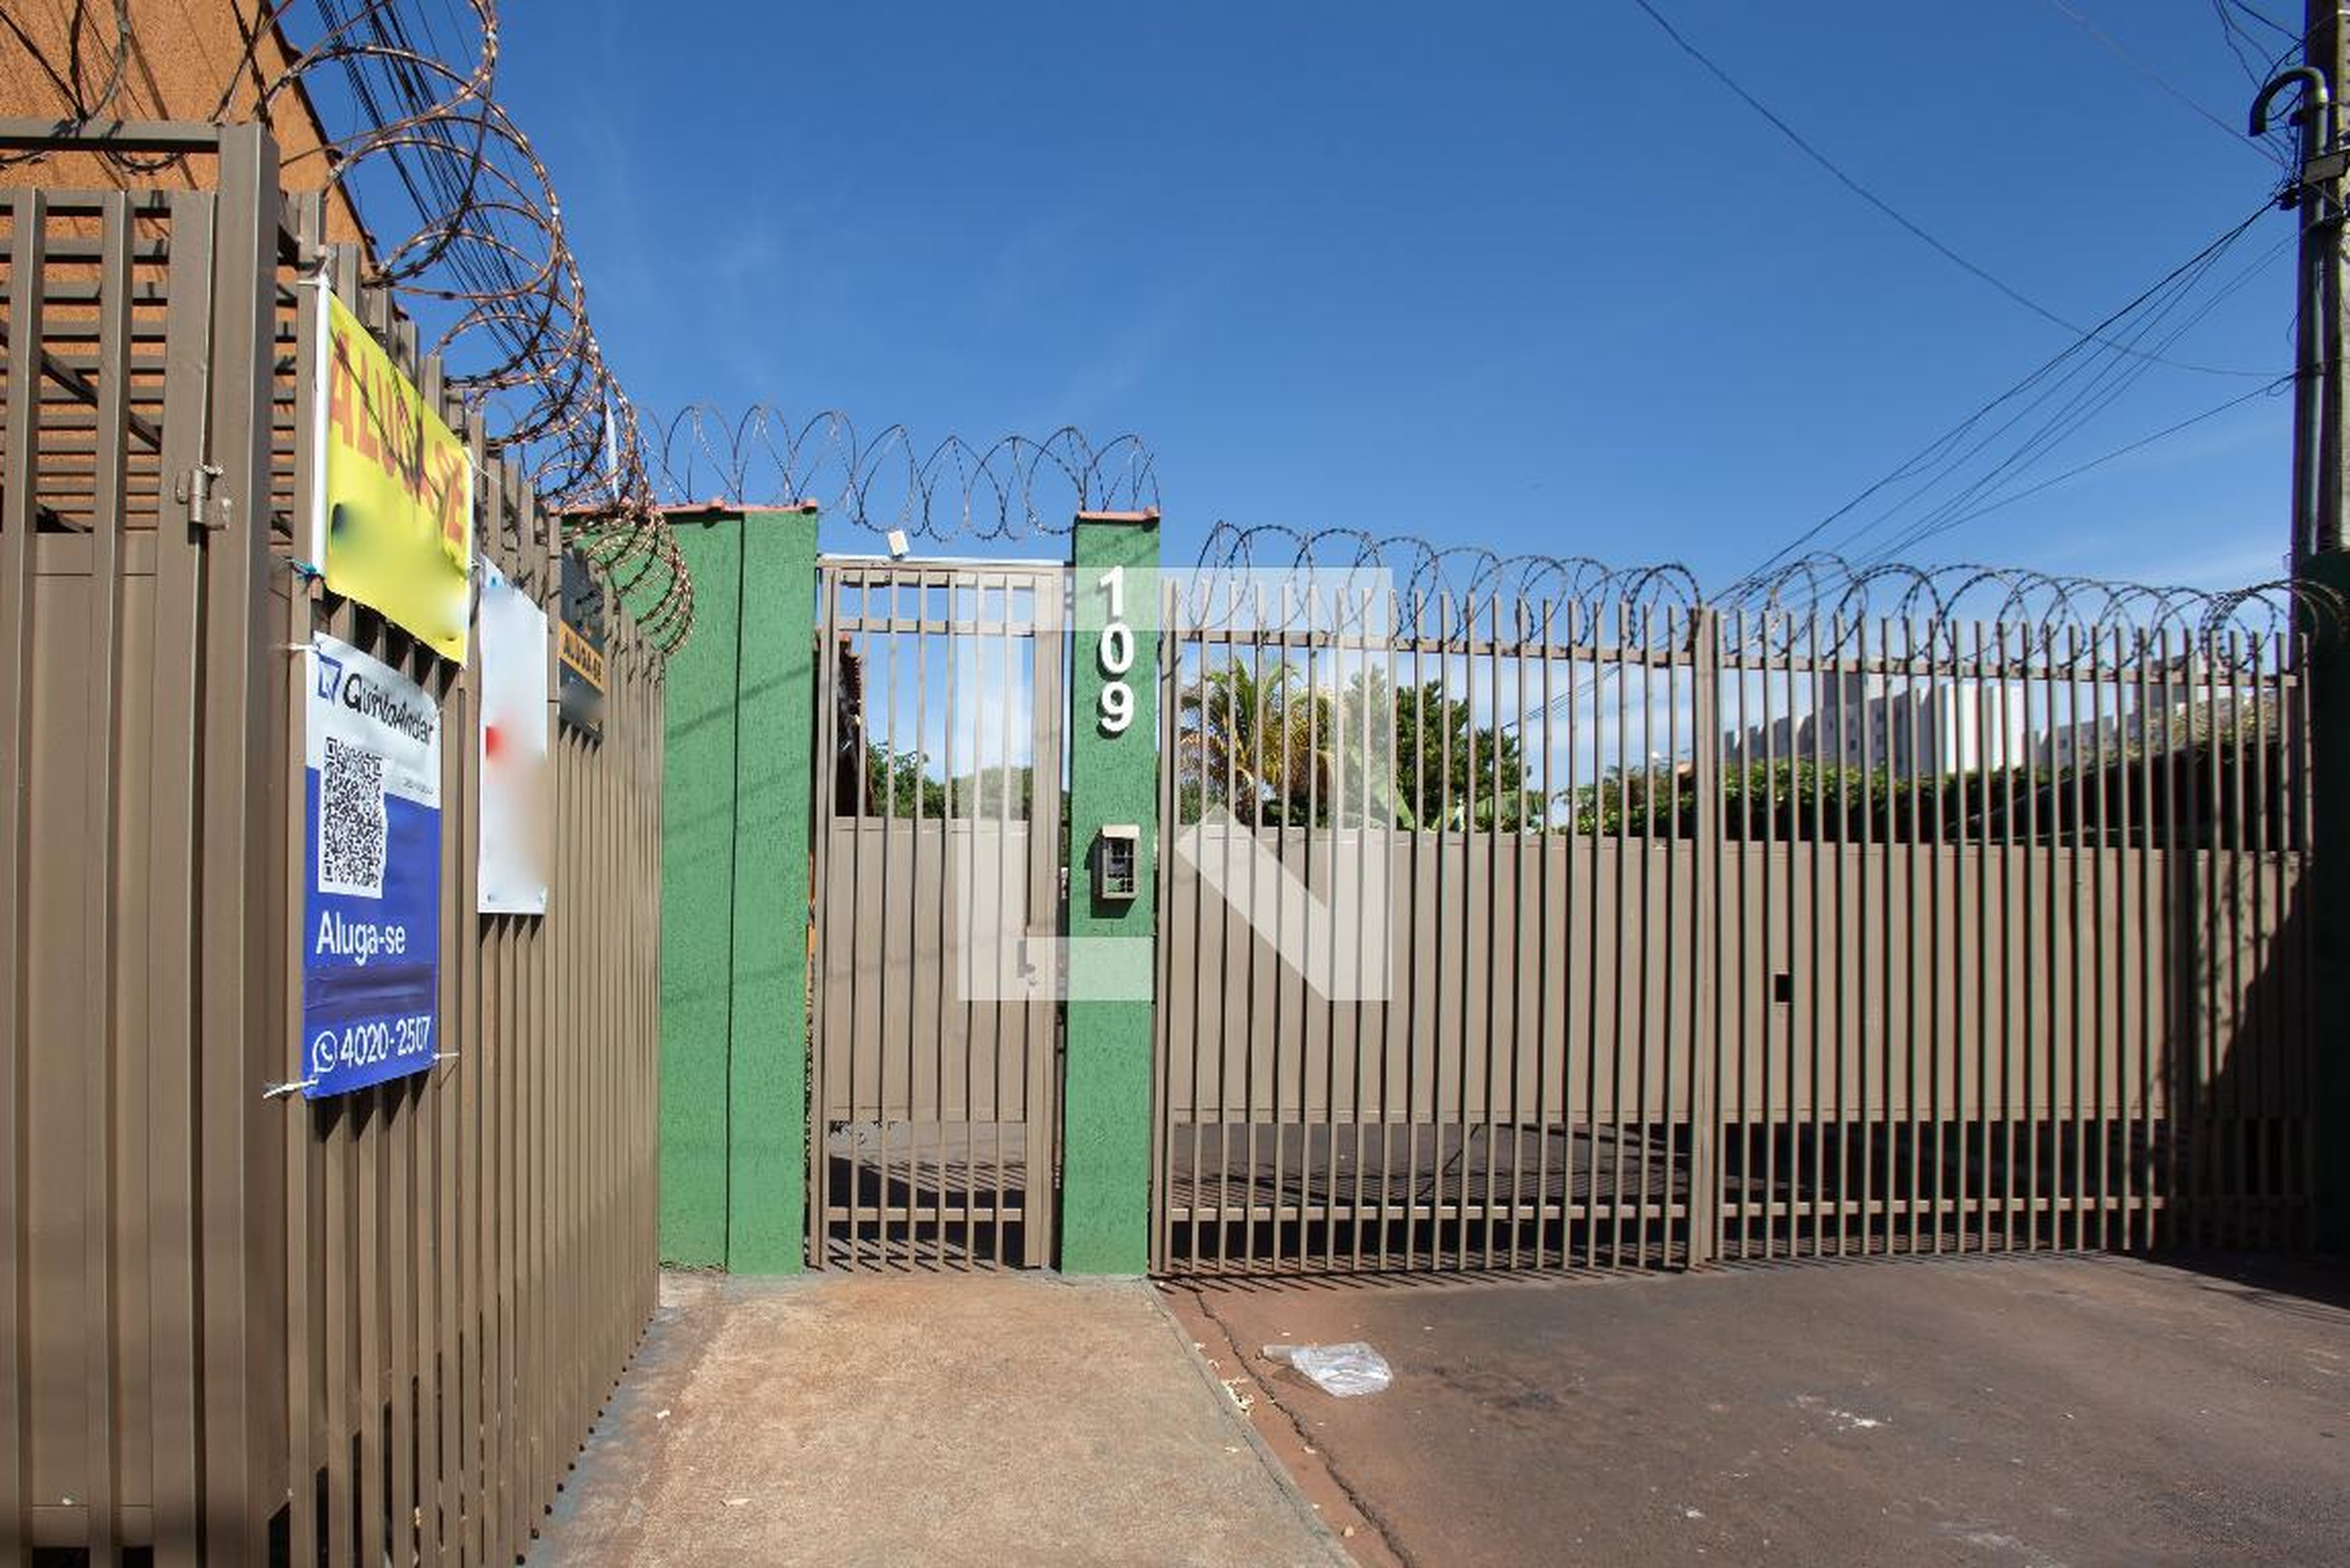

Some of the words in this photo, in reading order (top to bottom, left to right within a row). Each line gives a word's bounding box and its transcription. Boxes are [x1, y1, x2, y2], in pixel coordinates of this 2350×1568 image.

[1099, 565, 1134, 732] 109
[316, 910, 405, 966] Aluga-se
[340, 1017, 431, 1067] 4020-2507
